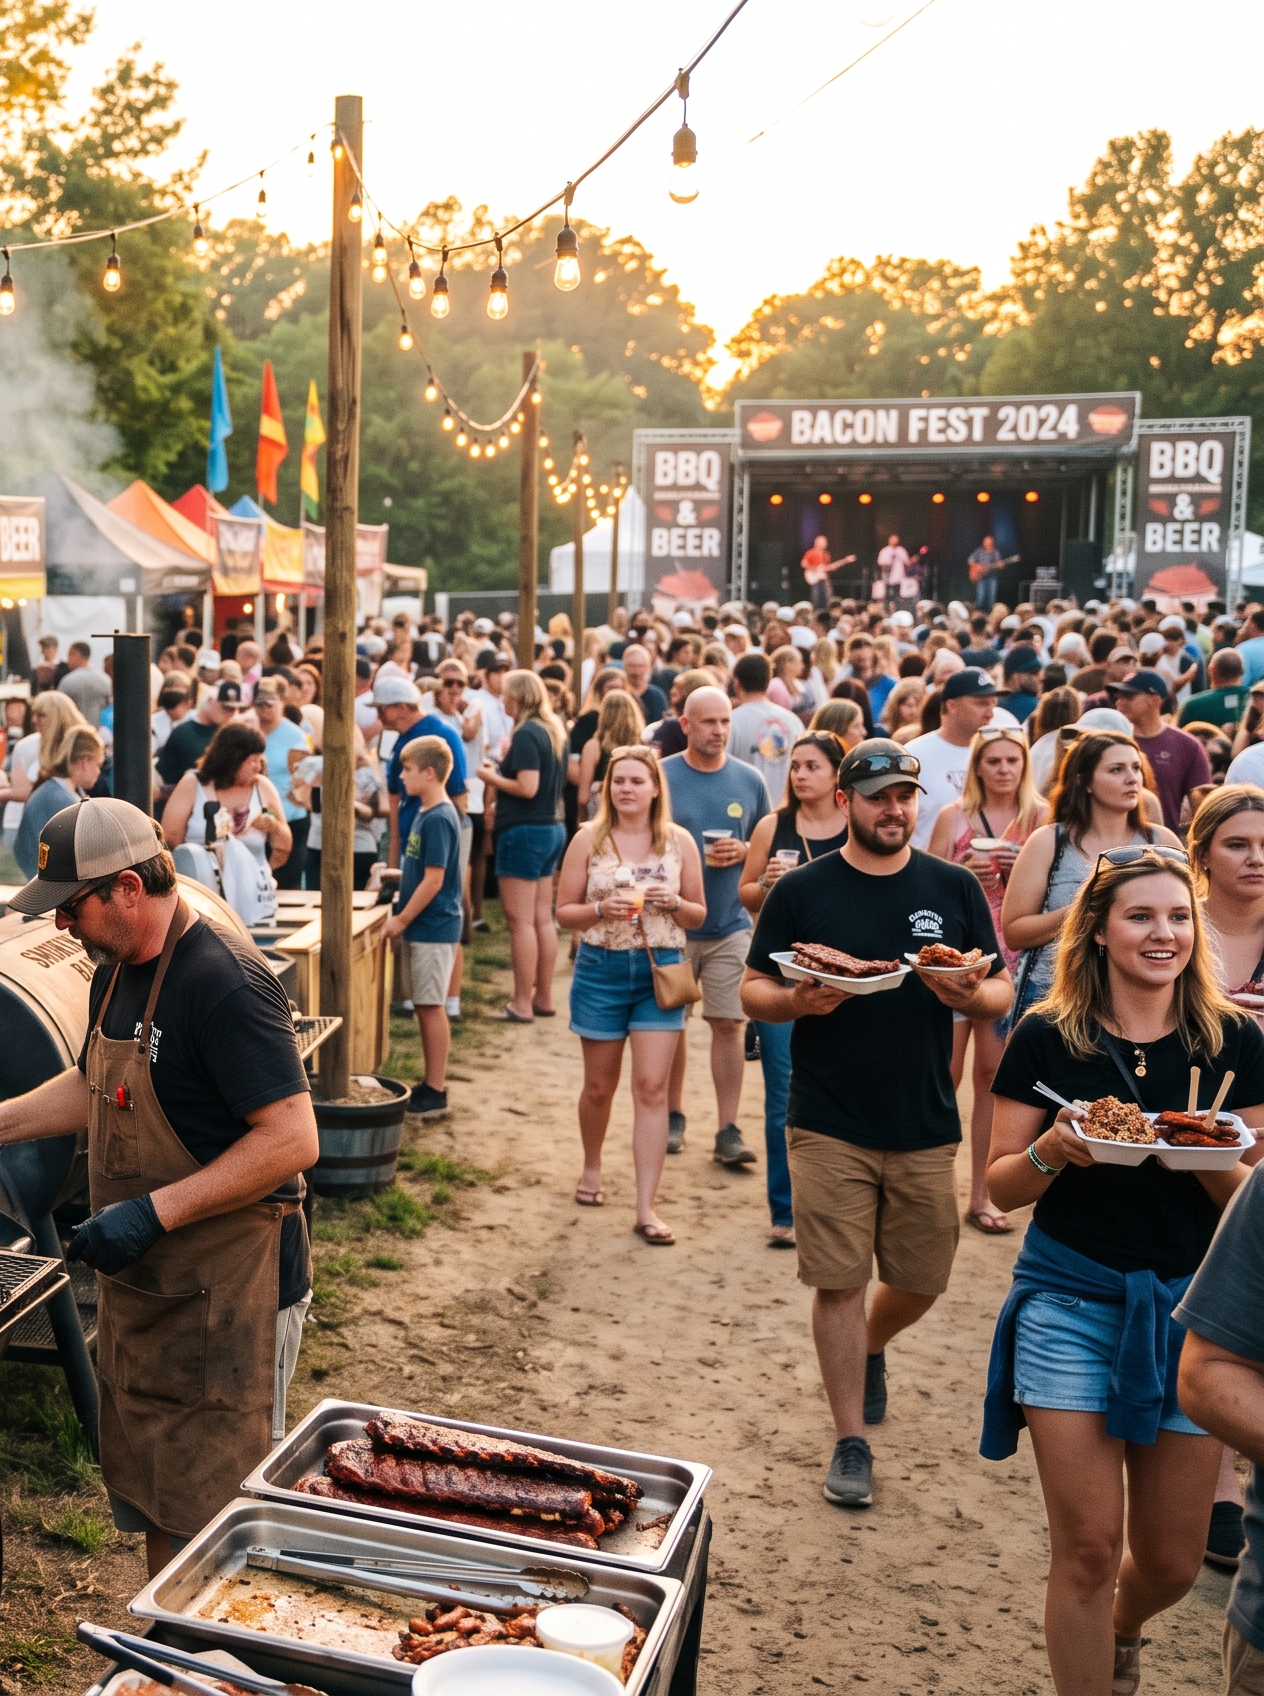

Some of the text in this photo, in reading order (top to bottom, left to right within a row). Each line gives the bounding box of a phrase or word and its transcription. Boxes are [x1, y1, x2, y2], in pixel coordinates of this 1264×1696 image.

[791, 403, 1080, 445] BACON FEST 2024
[653, 450, 722, 492] BBQ
[1149, 440, 1224, 485] BBQ
[676, 499, 698, 526] &
[1172, 492, 1195, 521] &
[0, 516, 41, 563] BEER
[650, 526, 722, 557] BEER
[1144, 521, 1221, 553] BEER
